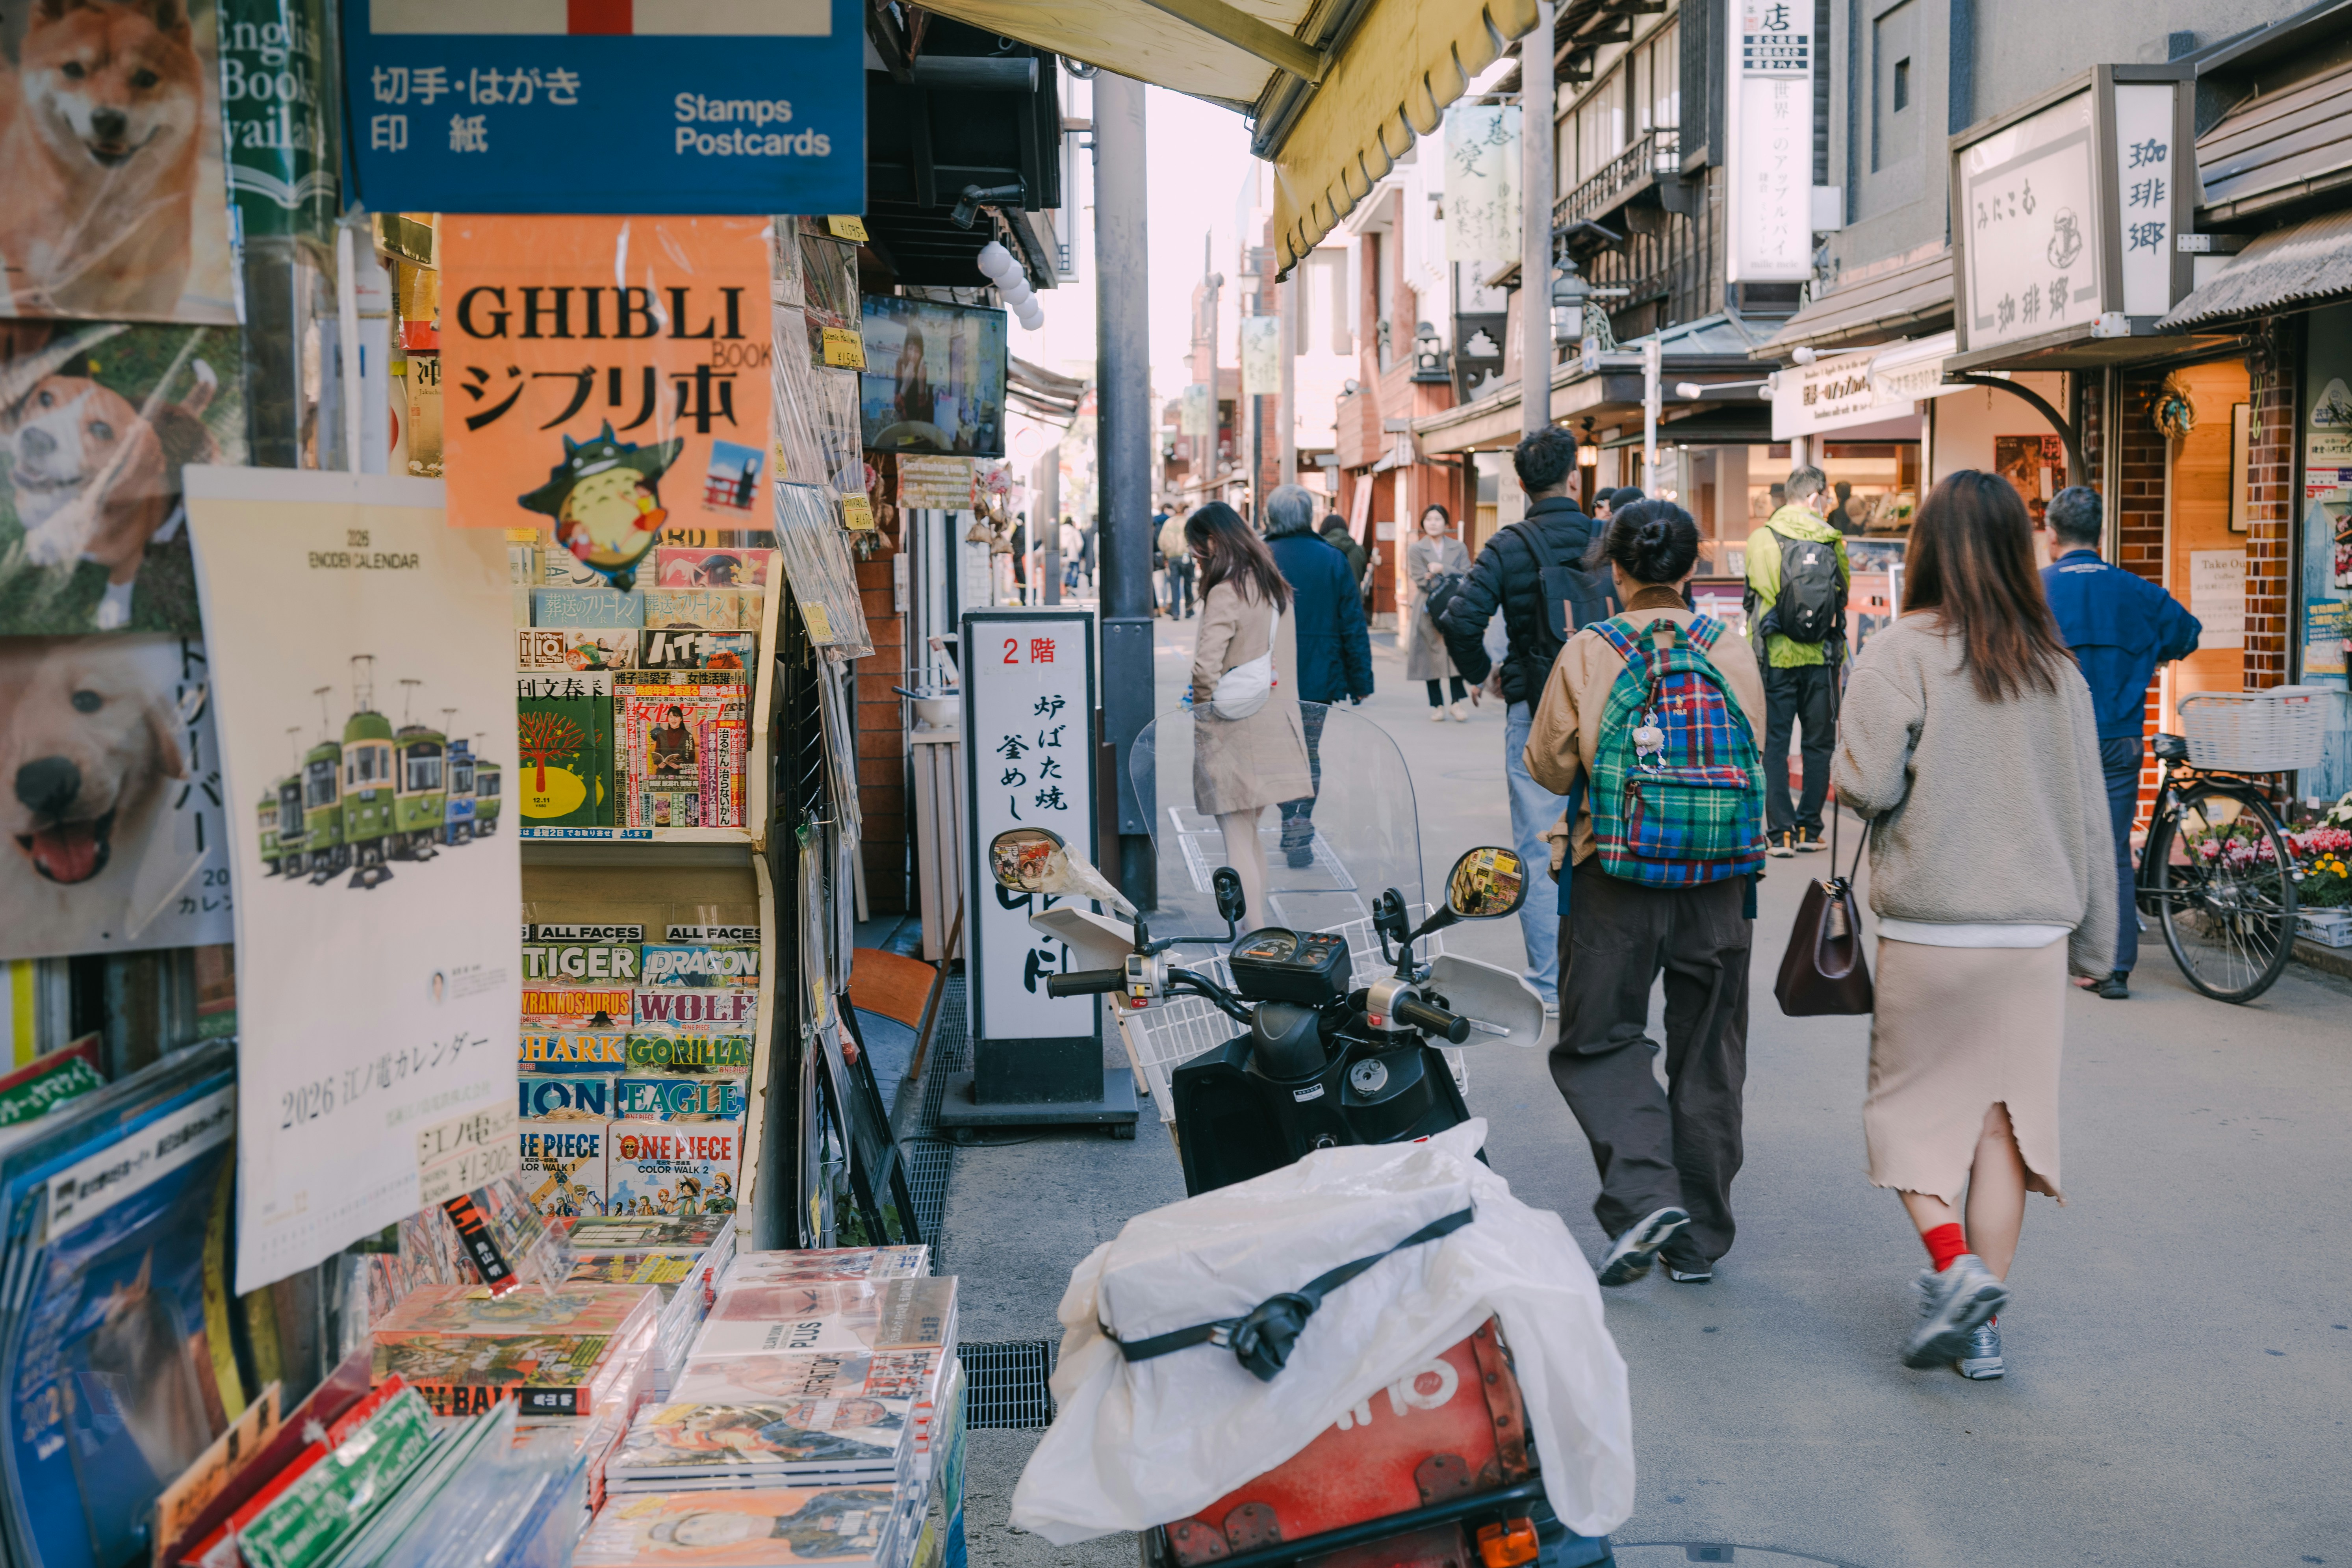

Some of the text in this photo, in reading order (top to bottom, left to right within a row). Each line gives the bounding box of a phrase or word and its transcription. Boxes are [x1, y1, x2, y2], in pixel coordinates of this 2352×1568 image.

[371, 66, 580, 106] 切手・はがき
[675, 93, 792, 126] Stamps
[676, 128, 831, 156] Postcards
[1772, 81, 1790, 256] 世界一のアップルパイ
[2128, 138, 2167, 255] 珈琲郷
[456, 286, 747, 340] GHIBLI
[1998, 276, 2069, 334] 珈琲郷
[825, 328, 857, 349] Scenic Railway
[712, 341, 772, 368] BOOK
[460, 364, 738, 434] ジブリ本
[354, 552, 419, 570] CALENDAR
[2202, 559, 2228, 569] Take
[545, 591, 638, 618] 葬送のフリーレン
[644, 591, 727, 616] 葬送のフリーレン
[648, 631, 751, 664] ハイキュー!!
[705, 649, 751, 663] magazine
[1003, 637, 1056, 664] 2階
[615, 672, 634, 685] 雅子
[650, 672, 670, 685] 愛子
[687, 672, 730, 685] 女性活躍
[719, 728, 730, 767] 治るがん
[1034, 695, 1068, 810] 炉ばた焼
[996, 734, 1029, 820] 釜めし
[615, 770, 626, 825] 残照の家族写真
[719, 769, 730, 825] 治らないがん
[567, 829, 648, 837] でお取り寄せたします
[542, 927, 640, 938] ALL FACES
[670, 927, 705, 939] ALL
[522, 947, 636, 978] TIGER
[648, 950, 759, 975] DRAGON
[638, 995, 754, 1023] WOLF
[631, 1039, 748, 1065] GORILLA
[342, 1031, 488, 1107] 江ノ電カレンダー
[281, 1076, 334, 1130] 2026
[518, 1082, 606, 1117] ION
[624, 1083, 740, 1115] EAGLE
[422, 1111, 491, 1166] 江ノ電
[543, 1134, 599, 1158] PIECE
[616, 1133, 732, 1162] ONE PIECE
[762, 1325, 784, 1350] SLAM DUNK
[789, 1322, 822, 1349] PLUS
